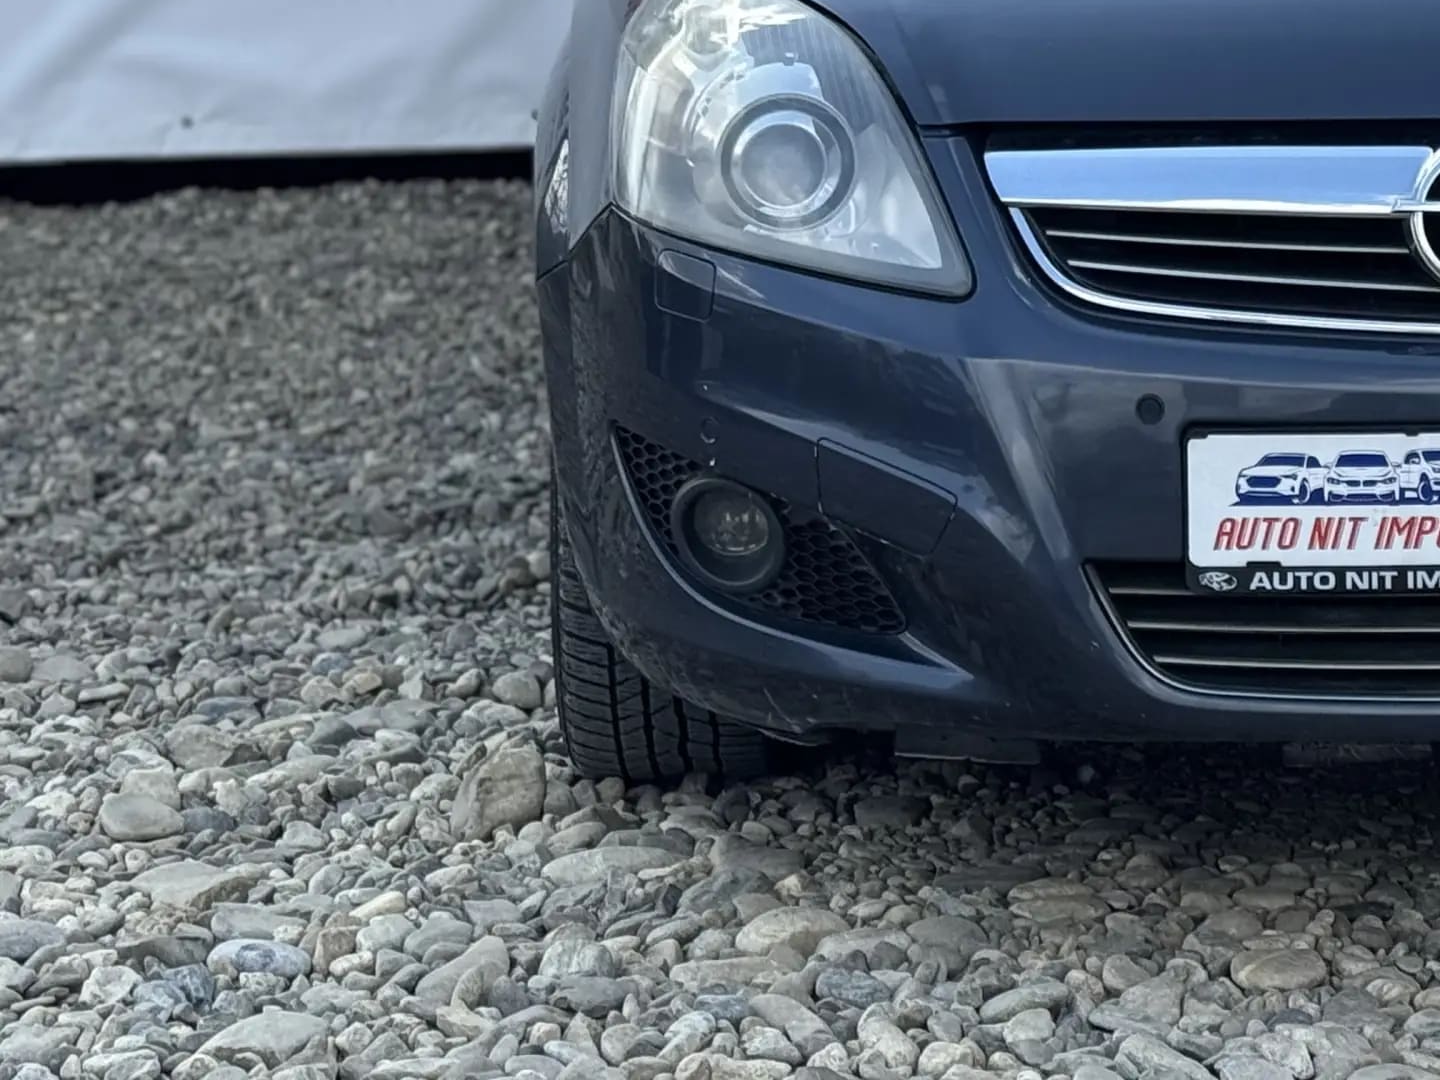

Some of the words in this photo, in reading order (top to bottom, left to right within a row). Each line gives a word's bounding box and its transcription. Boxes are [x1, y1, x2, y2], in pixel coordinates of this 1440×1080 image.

[1213, 517, 1302, 551] AUTO
[1307, 516, 1369, 550] NIT
[1249, 571, 1336, 591] AUTO
[1345, 570, 1398, 590] NIT
